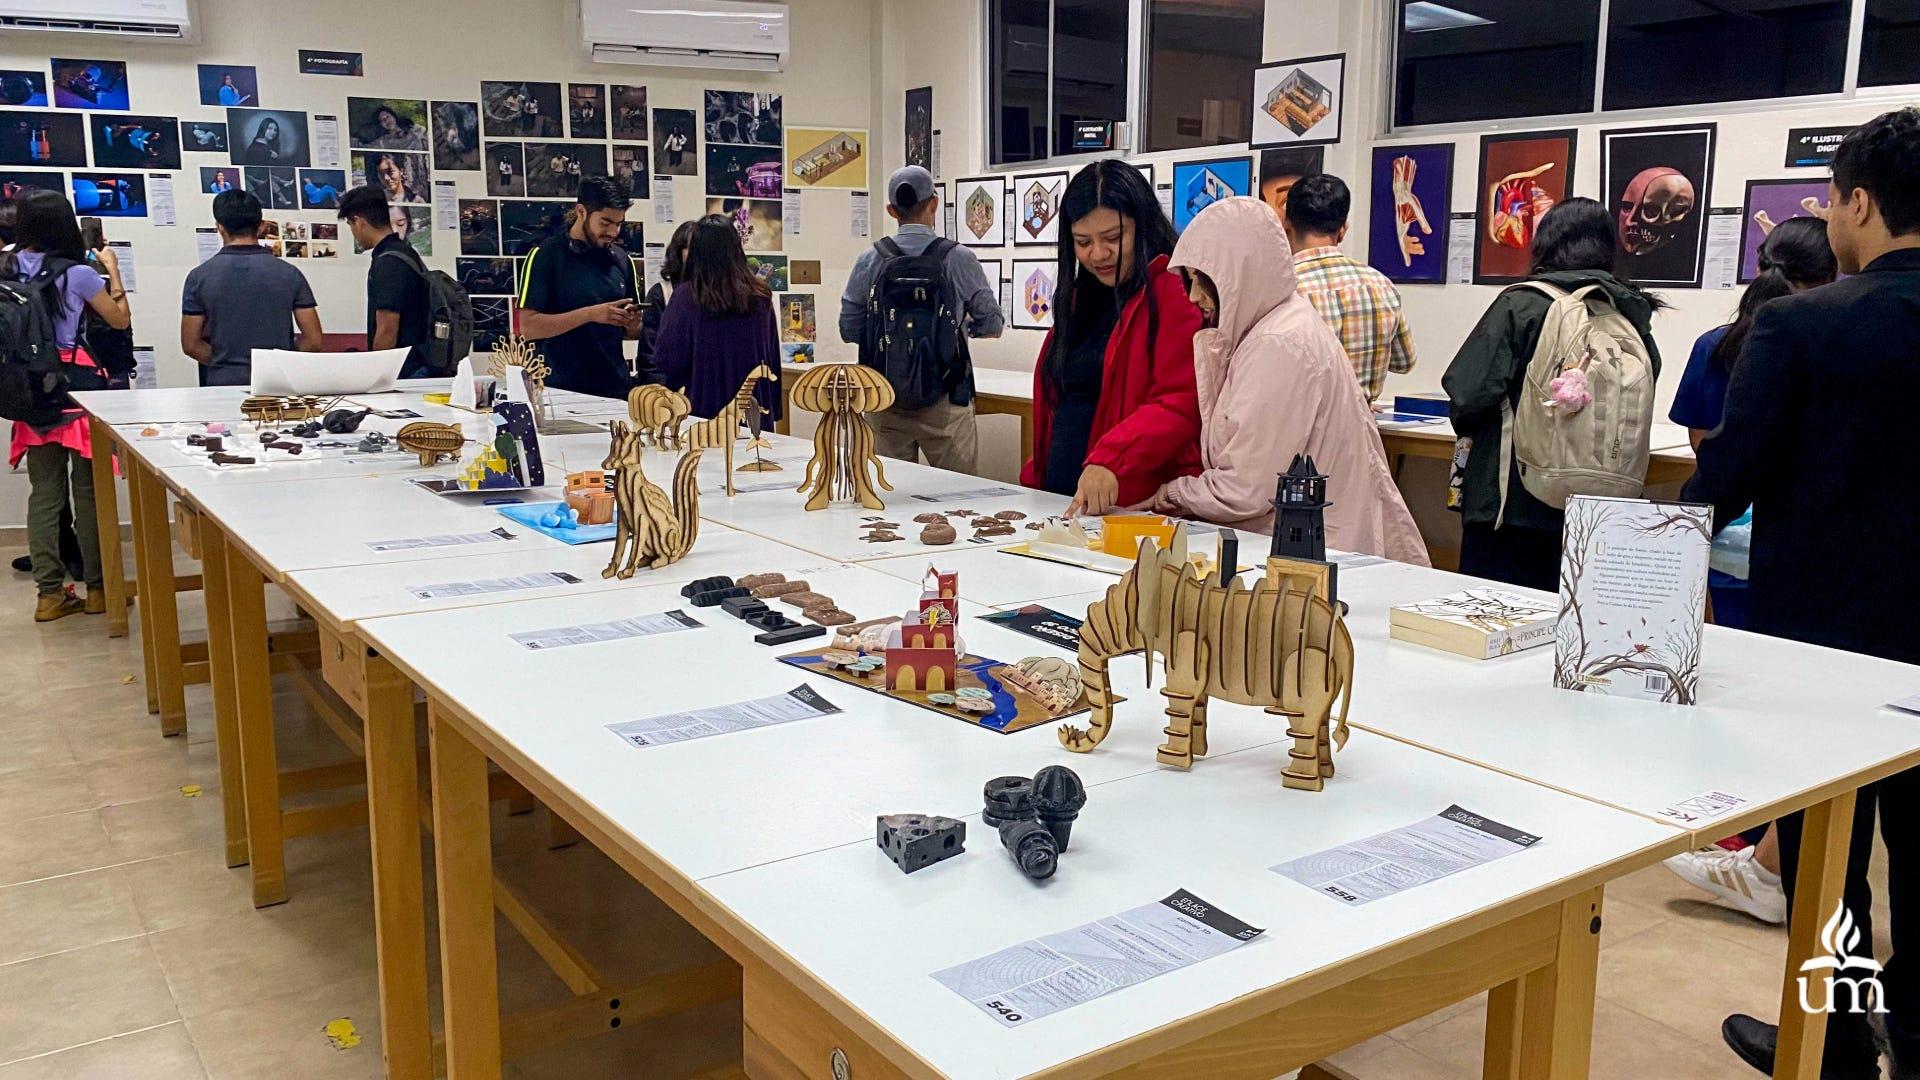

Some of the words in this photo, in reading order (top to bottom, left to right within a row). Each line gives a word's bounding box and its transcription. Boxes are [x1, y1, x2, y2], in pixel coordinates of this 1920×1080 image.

[759, 23, 768, 31] 20
[1324, 886, 1357, 901] 558
[1170, 900, 1205, 918] CREATIVO
[1180, 897, 1208, 913] ENLACE
[986, 1001, 1022, 1021] 540
